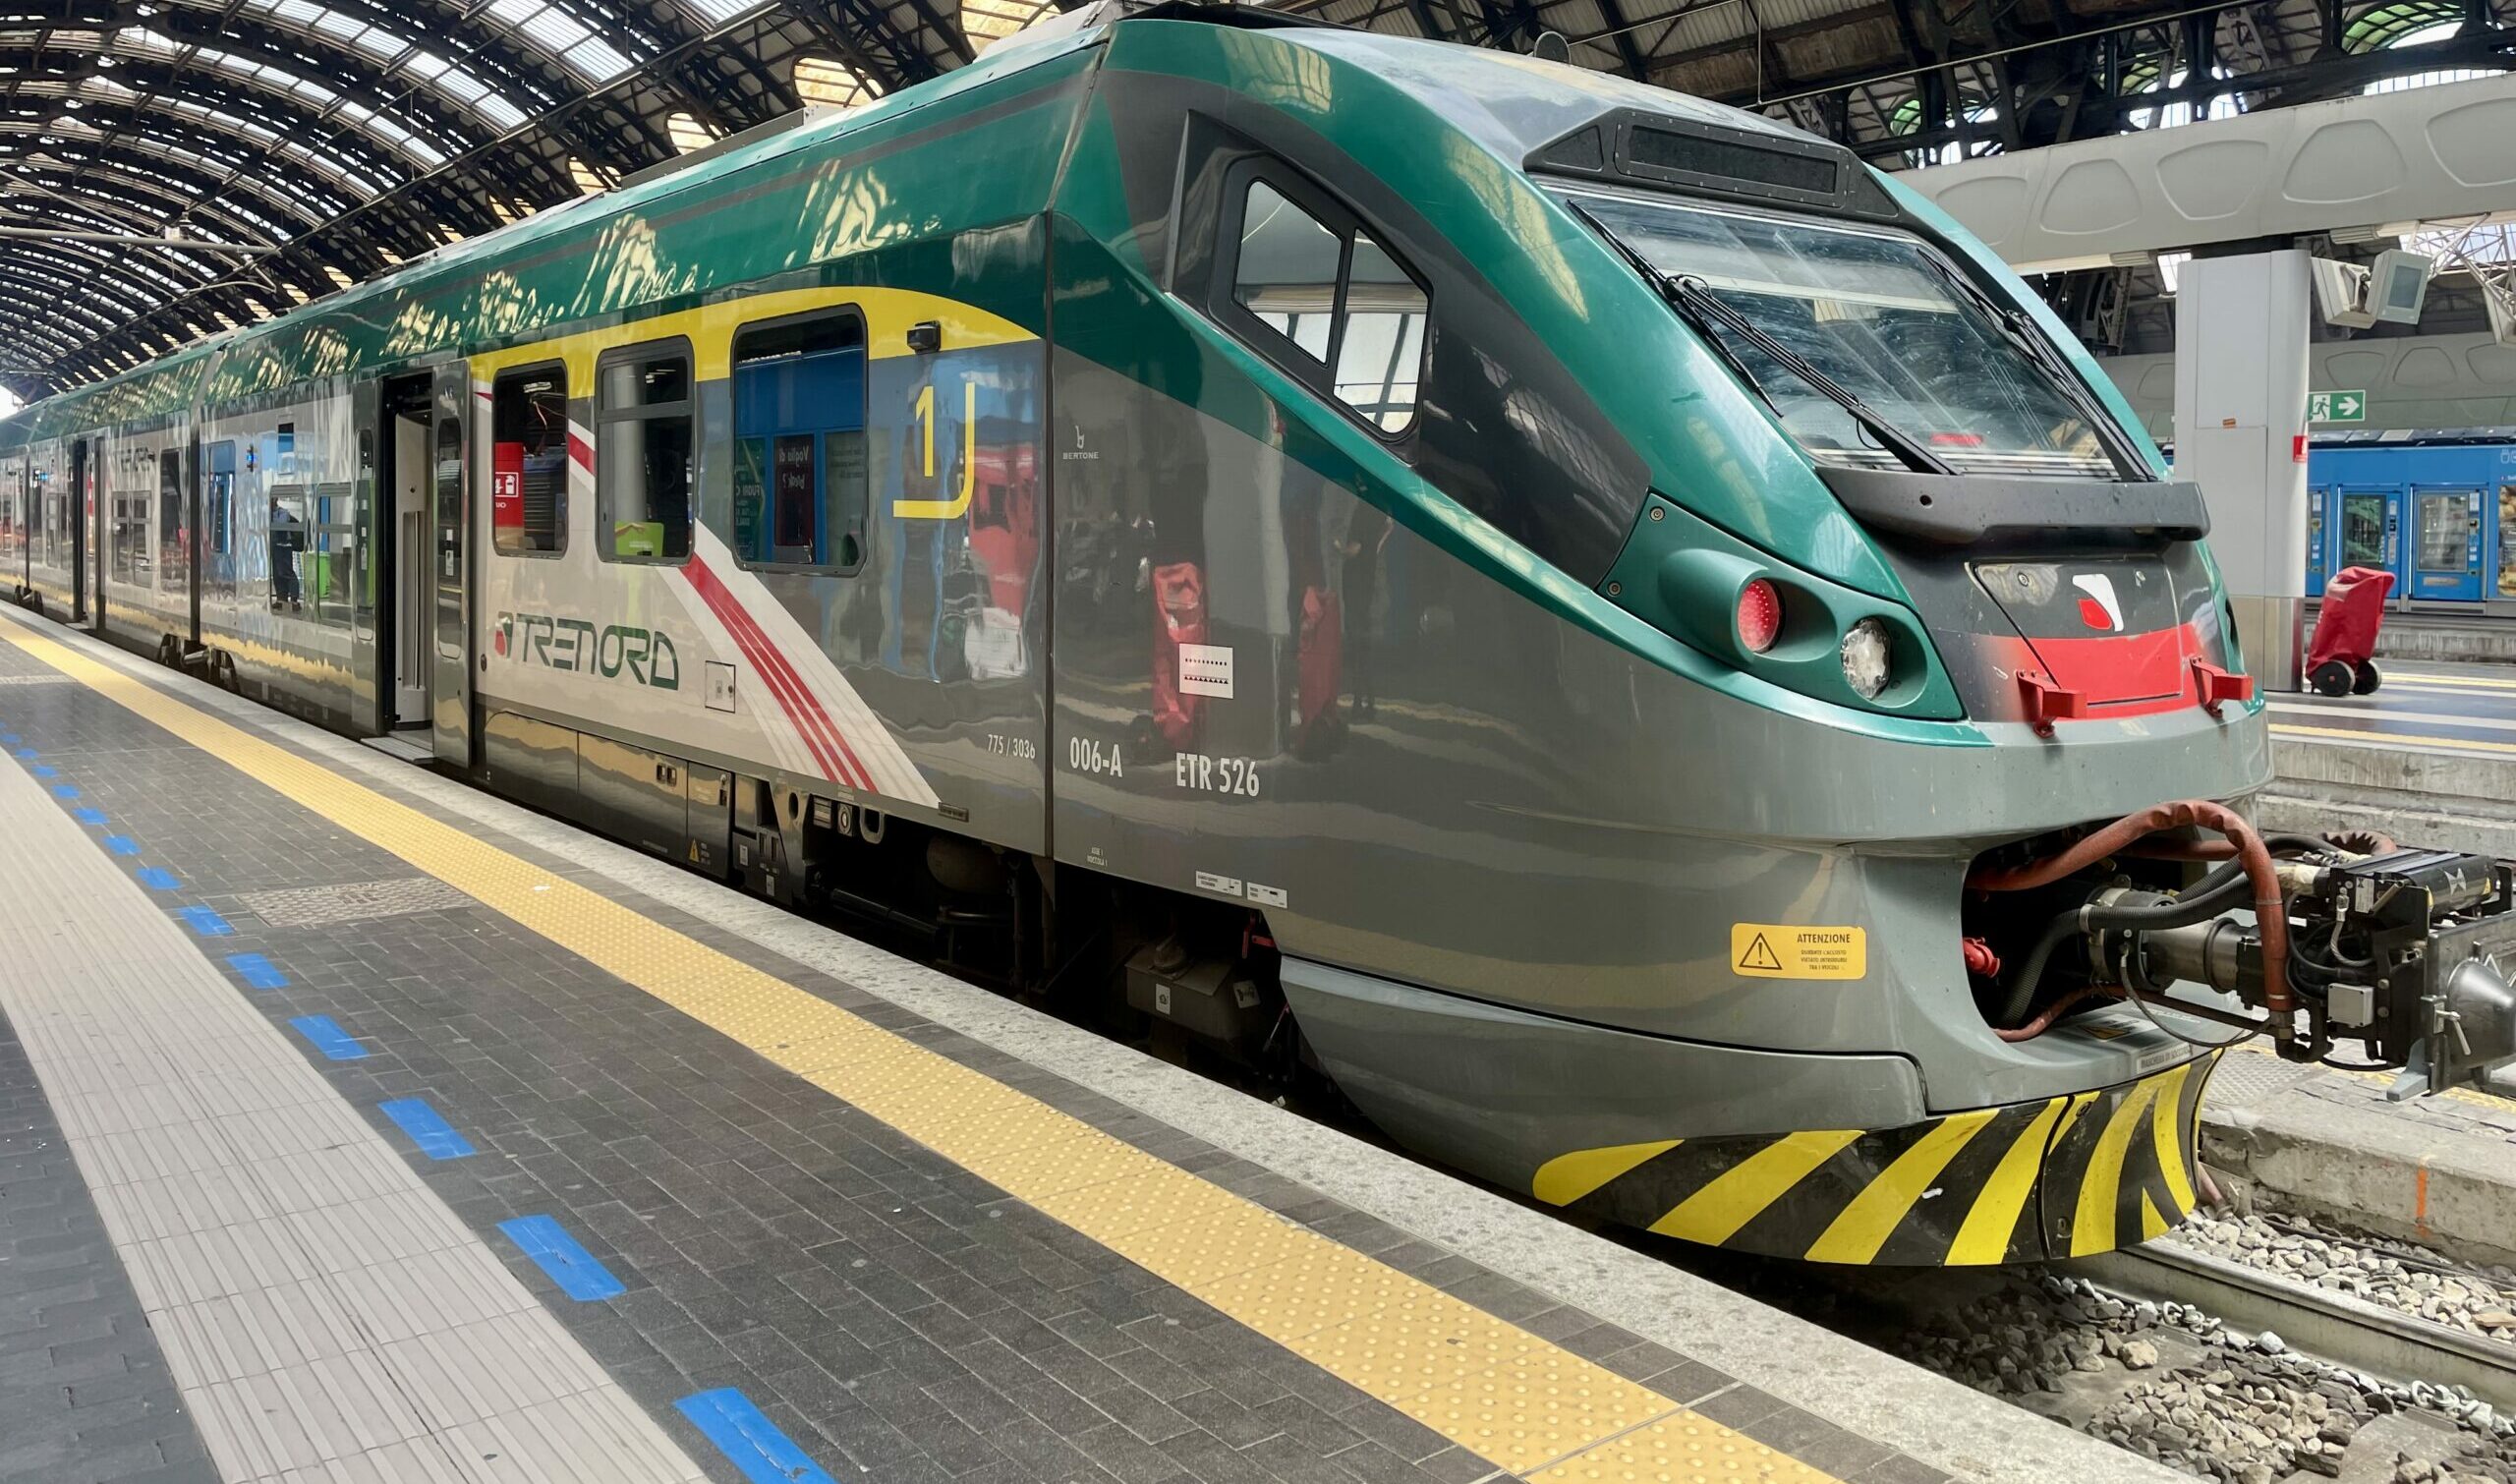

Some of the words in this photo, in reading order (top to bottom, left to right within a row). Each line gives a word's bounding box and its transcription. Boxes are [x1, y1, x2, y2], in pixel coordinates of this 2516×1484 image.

[516, 613, 679, 691] TRENORD
[988, 733, 1003, 755] 775
[1012, 737, 1036, 760] 3036
[1069, 737, 1123, 777] 006-A
[1175, 752, 1213, 791] ETR
[1218, 758, 1260, 797] 526
[1797, 934, 1851, 943] ATTENZIONE
